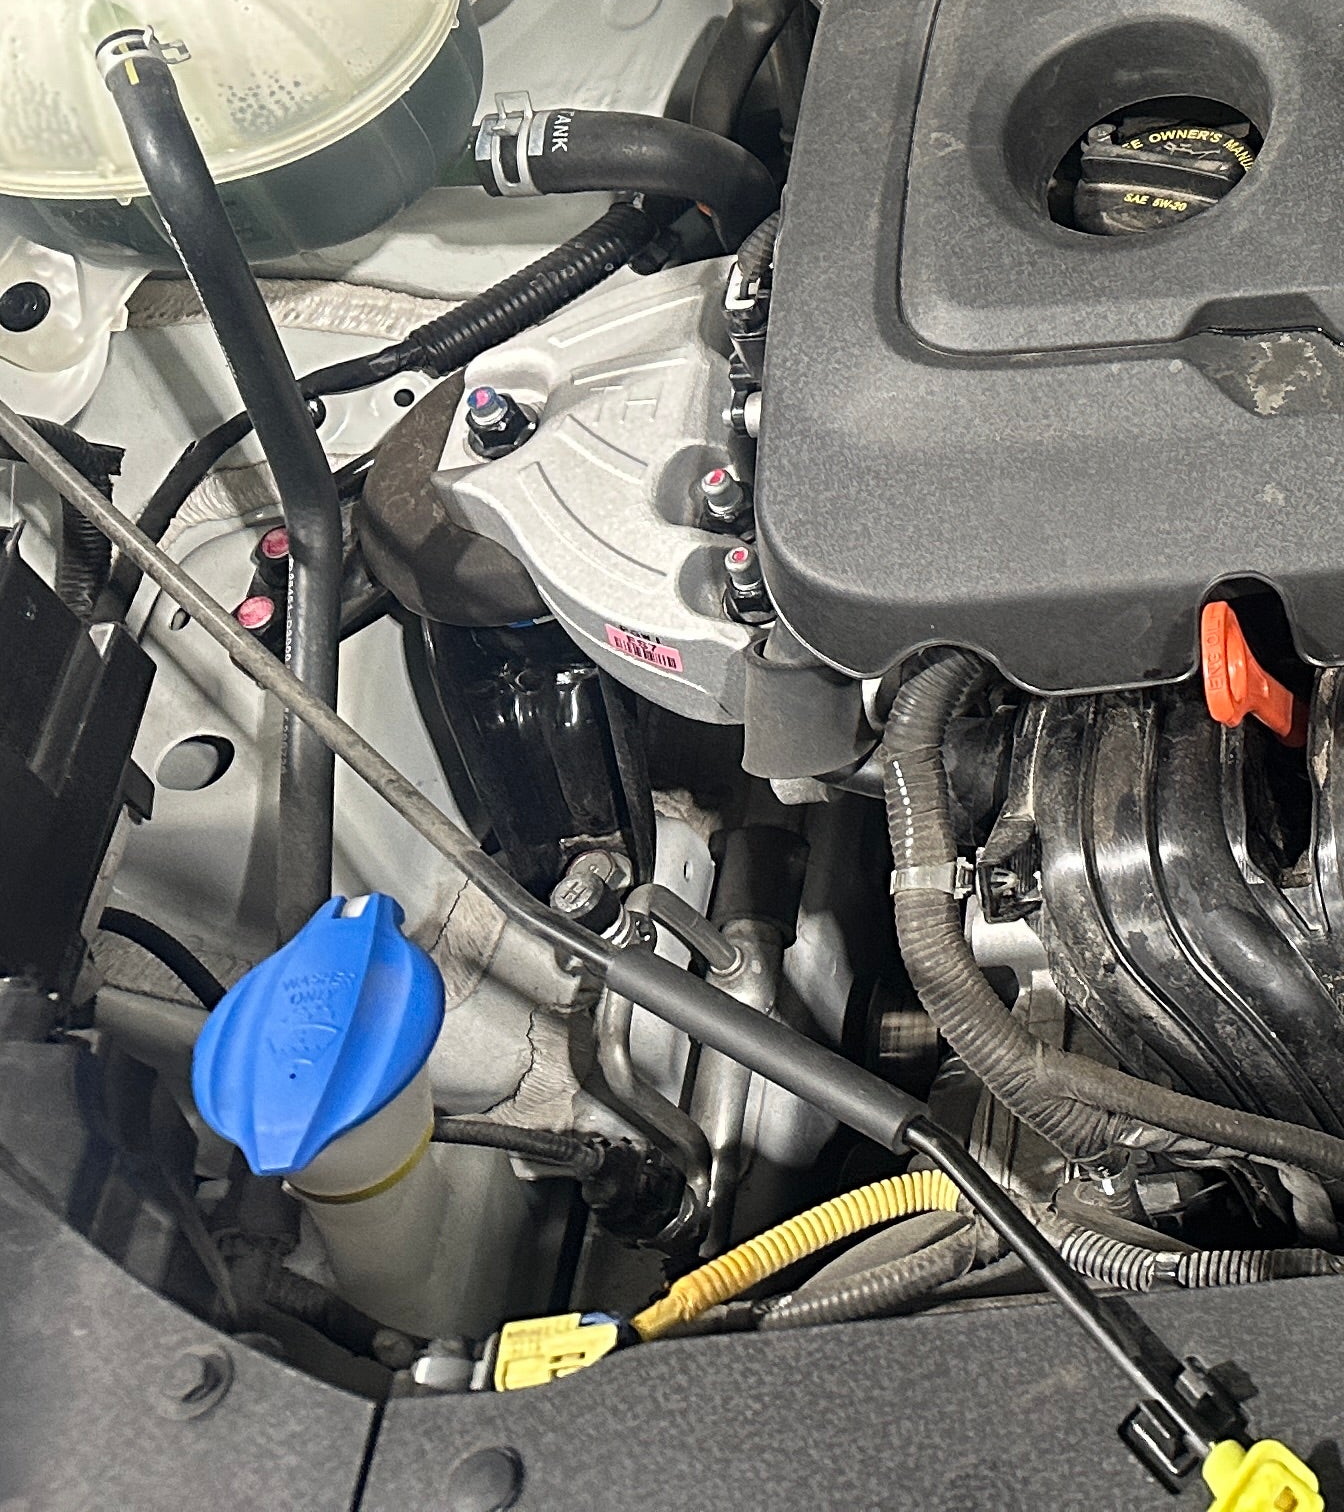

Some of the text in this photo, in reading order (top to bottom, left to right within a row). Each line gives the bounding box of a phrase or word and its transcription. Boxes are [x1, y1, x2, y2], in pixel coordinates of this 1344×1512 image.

[551, 110, 576, 153] TANK
[1148, 128, 1223, 144] OWNER'S
[1123, 192, 1188, 212] SAE 5W-20
[1206, 651, 1224, 690] ENG
